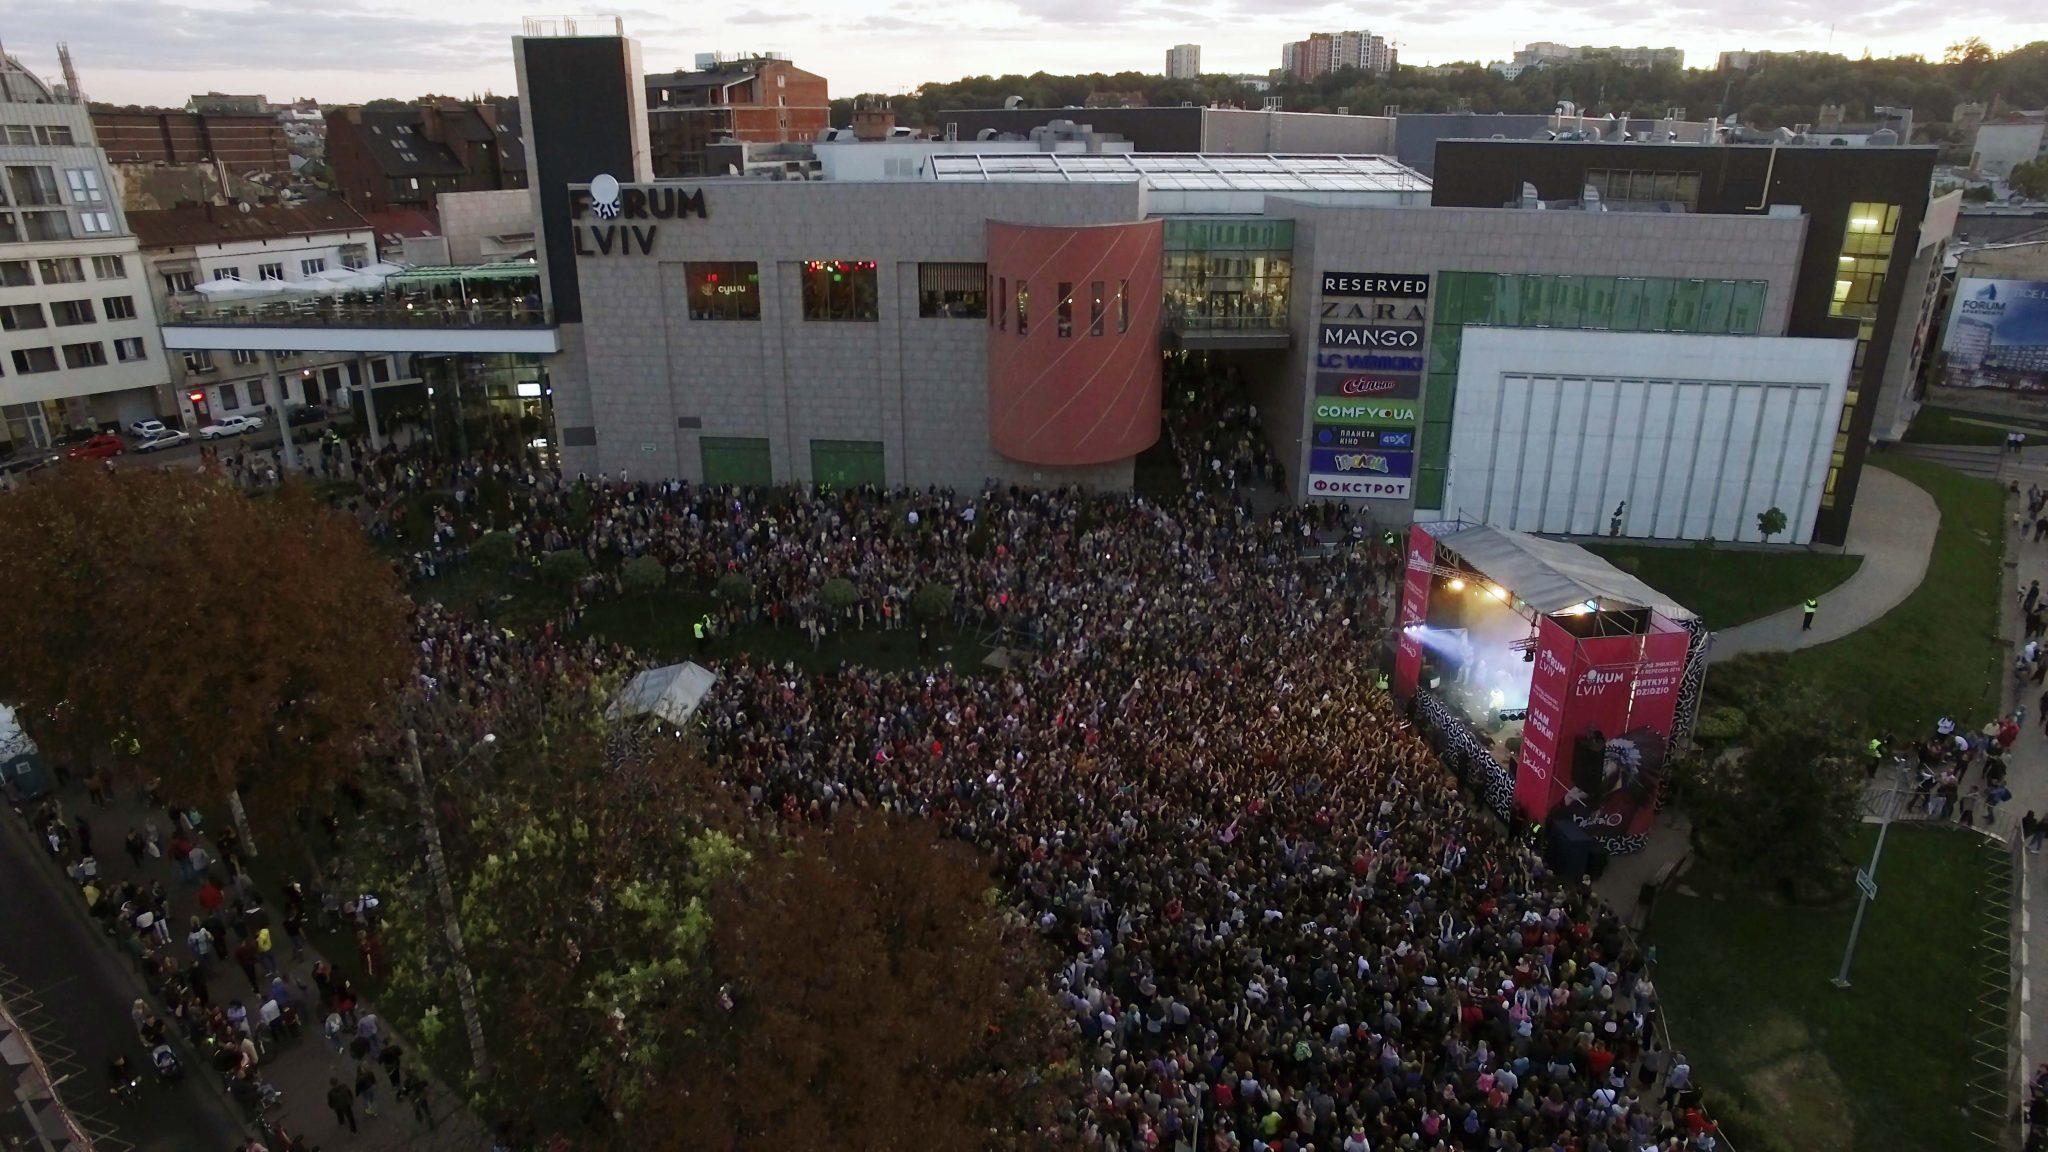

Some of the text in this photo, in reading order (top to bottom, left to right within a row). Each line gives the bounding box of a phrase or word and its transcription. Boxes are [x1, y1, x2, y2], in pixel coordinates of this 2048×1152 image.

[573, 224, 657, 256] LVIV
[1325, 278, 1426, 293] RESERVED
[1321, 302, 1425, 320] ZARA
[1962, 300, 2007, 311] FORUM
[1325, 328, 1418, 347] MANGO
[1317, 405, 1378, 419] COMFY
[1340, 429, 1375, 437] ПЛАНЕТА
[1314, 479, 1405, 494] ФОКСТРОТ
[1540, 660, 1555, 678] LVIV
[1578, 670, 1624, 685] FORUM
[1575, 684, 1606, 696] LVIV
[1534, 707, 1550, 726] НАМ
